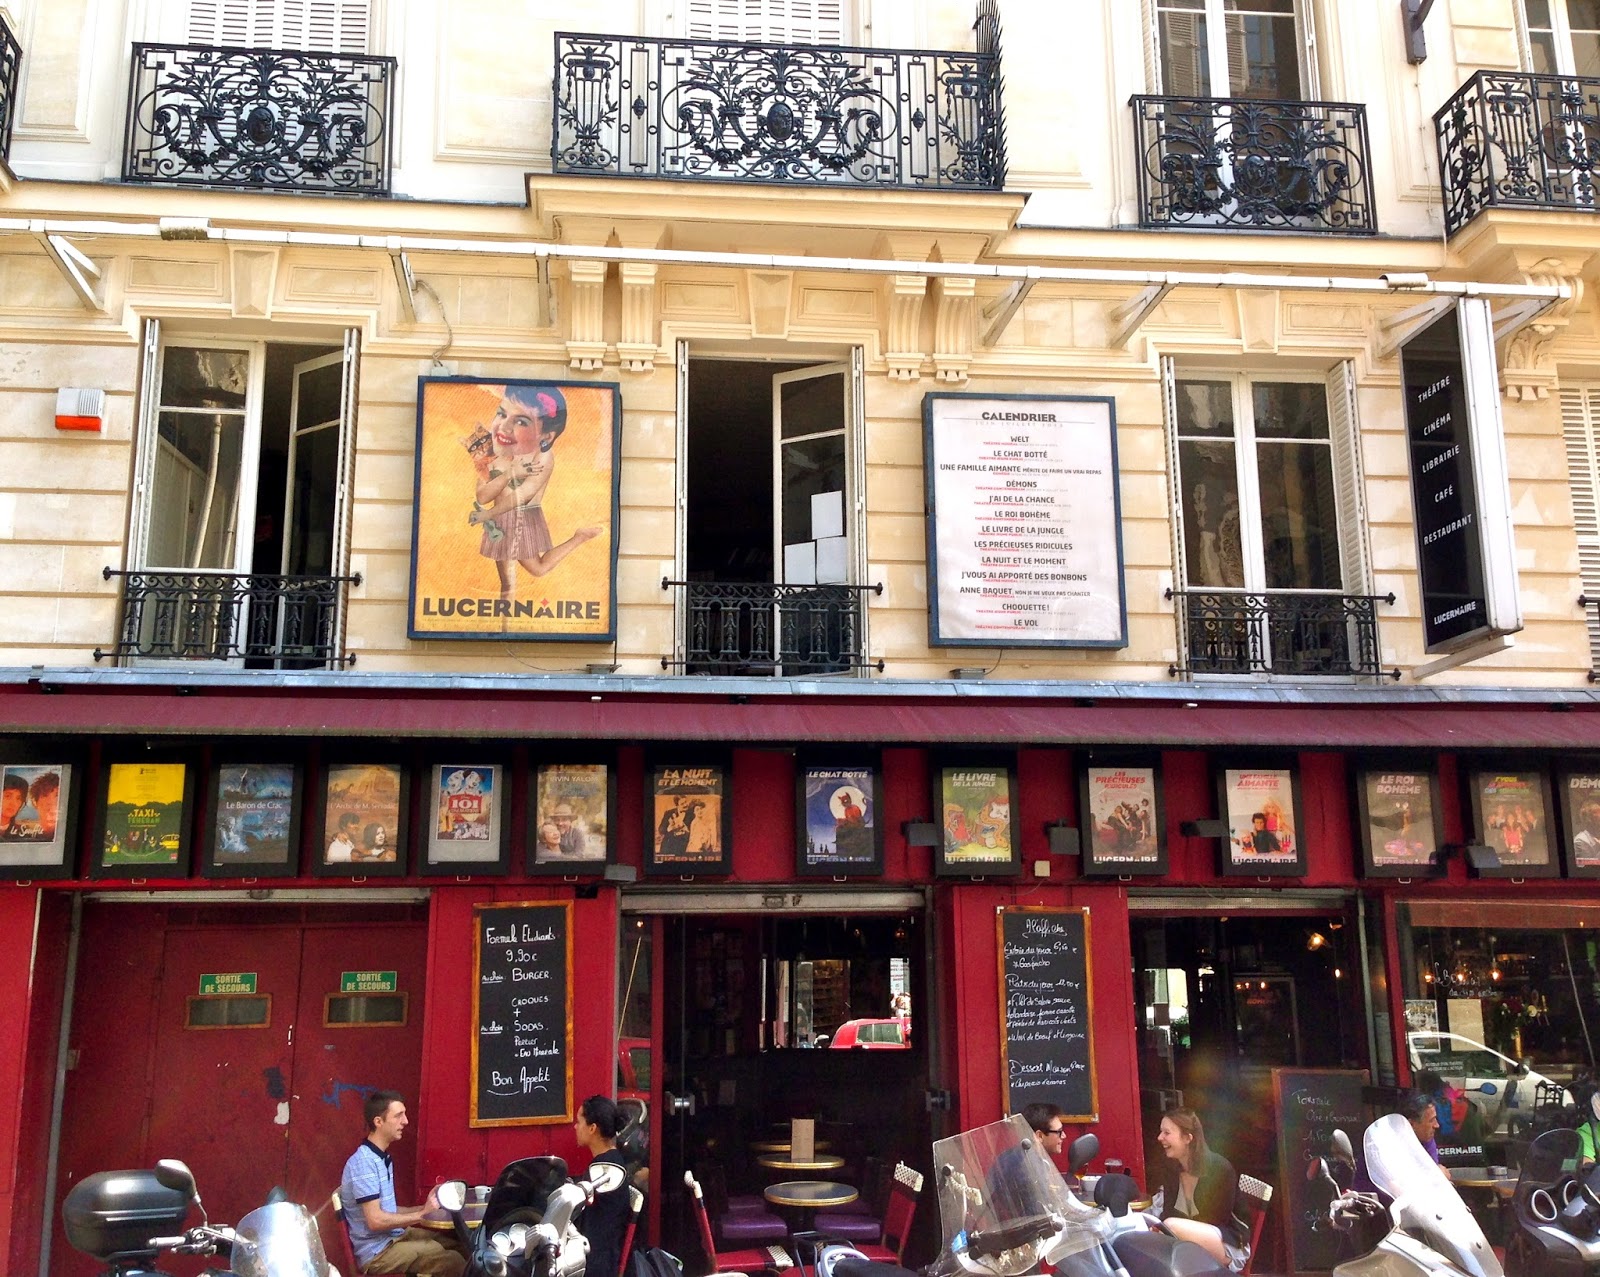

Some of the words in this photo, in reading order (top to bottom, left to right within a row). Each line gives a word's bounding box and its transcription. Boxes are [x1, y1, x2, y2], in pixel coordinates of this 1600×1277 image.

[1418, 375, 1450, 403] THÉÂTRE
[982, 412, 1057, 422] CALENDRIER
[1423, 412, 1451, 436] CINÉMA
[1024, 450, 1048, 458] BOTTÉ
[1422, 445, 1460, 473] LIBRAIRIE
[957, 464, 987, 472] FAMILLE
[988, 465, 1021, 473] AIMANTE
[1006, 480, 1038, 488] DÉMONS
[1434, 485, 1454, 503] CAFÉ
[1025, 496, 1055, 504] CHANCE
[1015, 526, 1025, 534] DE
[1424, 514, 1472, 545] RESTAURANT
[974, 540, 987, 548] LES
[988, 540, 1034, 549] PRÉCIEUSES
[1035, 542, 1073, 550] RIDICULES
[992, 556, 1011, 564] NUIT
[961, 571, 987, 579] J'VOUS
[998, 572, 1033, 580] APPORTÉ
[960, 586, 981, 594] ANNE
[982, 587, 1013, 596] BAQUET
[423, 597, 601, 620] LUCERNAIRE
[1434, 601, 1476, 626] LUCERNAIRE
[663, 769, 680, 779] LA
[682, 769, 714, 779] NUIT
[843, 770, 868, 778] BOTTÉ
[952, 773, 966, 781] LE
[966, 773, 997, 782] LIVRE
[1095, 776, 1146, 784] PRÉCIEUSES
[1381, 775, 1395, 784] LE
[1396, 775, 1415, 784] ROI
[226, 801, 235, 809] Le
[236, 801, 256, 809] Baron
[256, 801, 266, 809] de
[266, 801, 283, 809] Crac
[452, 799, 479, 810] 101
[133, 808, 155, 818] TAXI
[215, 975, 242, 984] SORTIE
[356, 973, 382, 982] SORTIE
[205, 984, 214, 992] DE
[217, 984, 251, 992] SECOURS
[346, 982, 356, 991] DE
[358, 982, 391, 990] SECOURS
[512, 996, 548, 1008] CROQUES
[492, 1070, 514, 1086] Bon
[520, 1066, 550, 1094] Appetit
[1436, 1146, 1482, 1156] CERNAIRE
